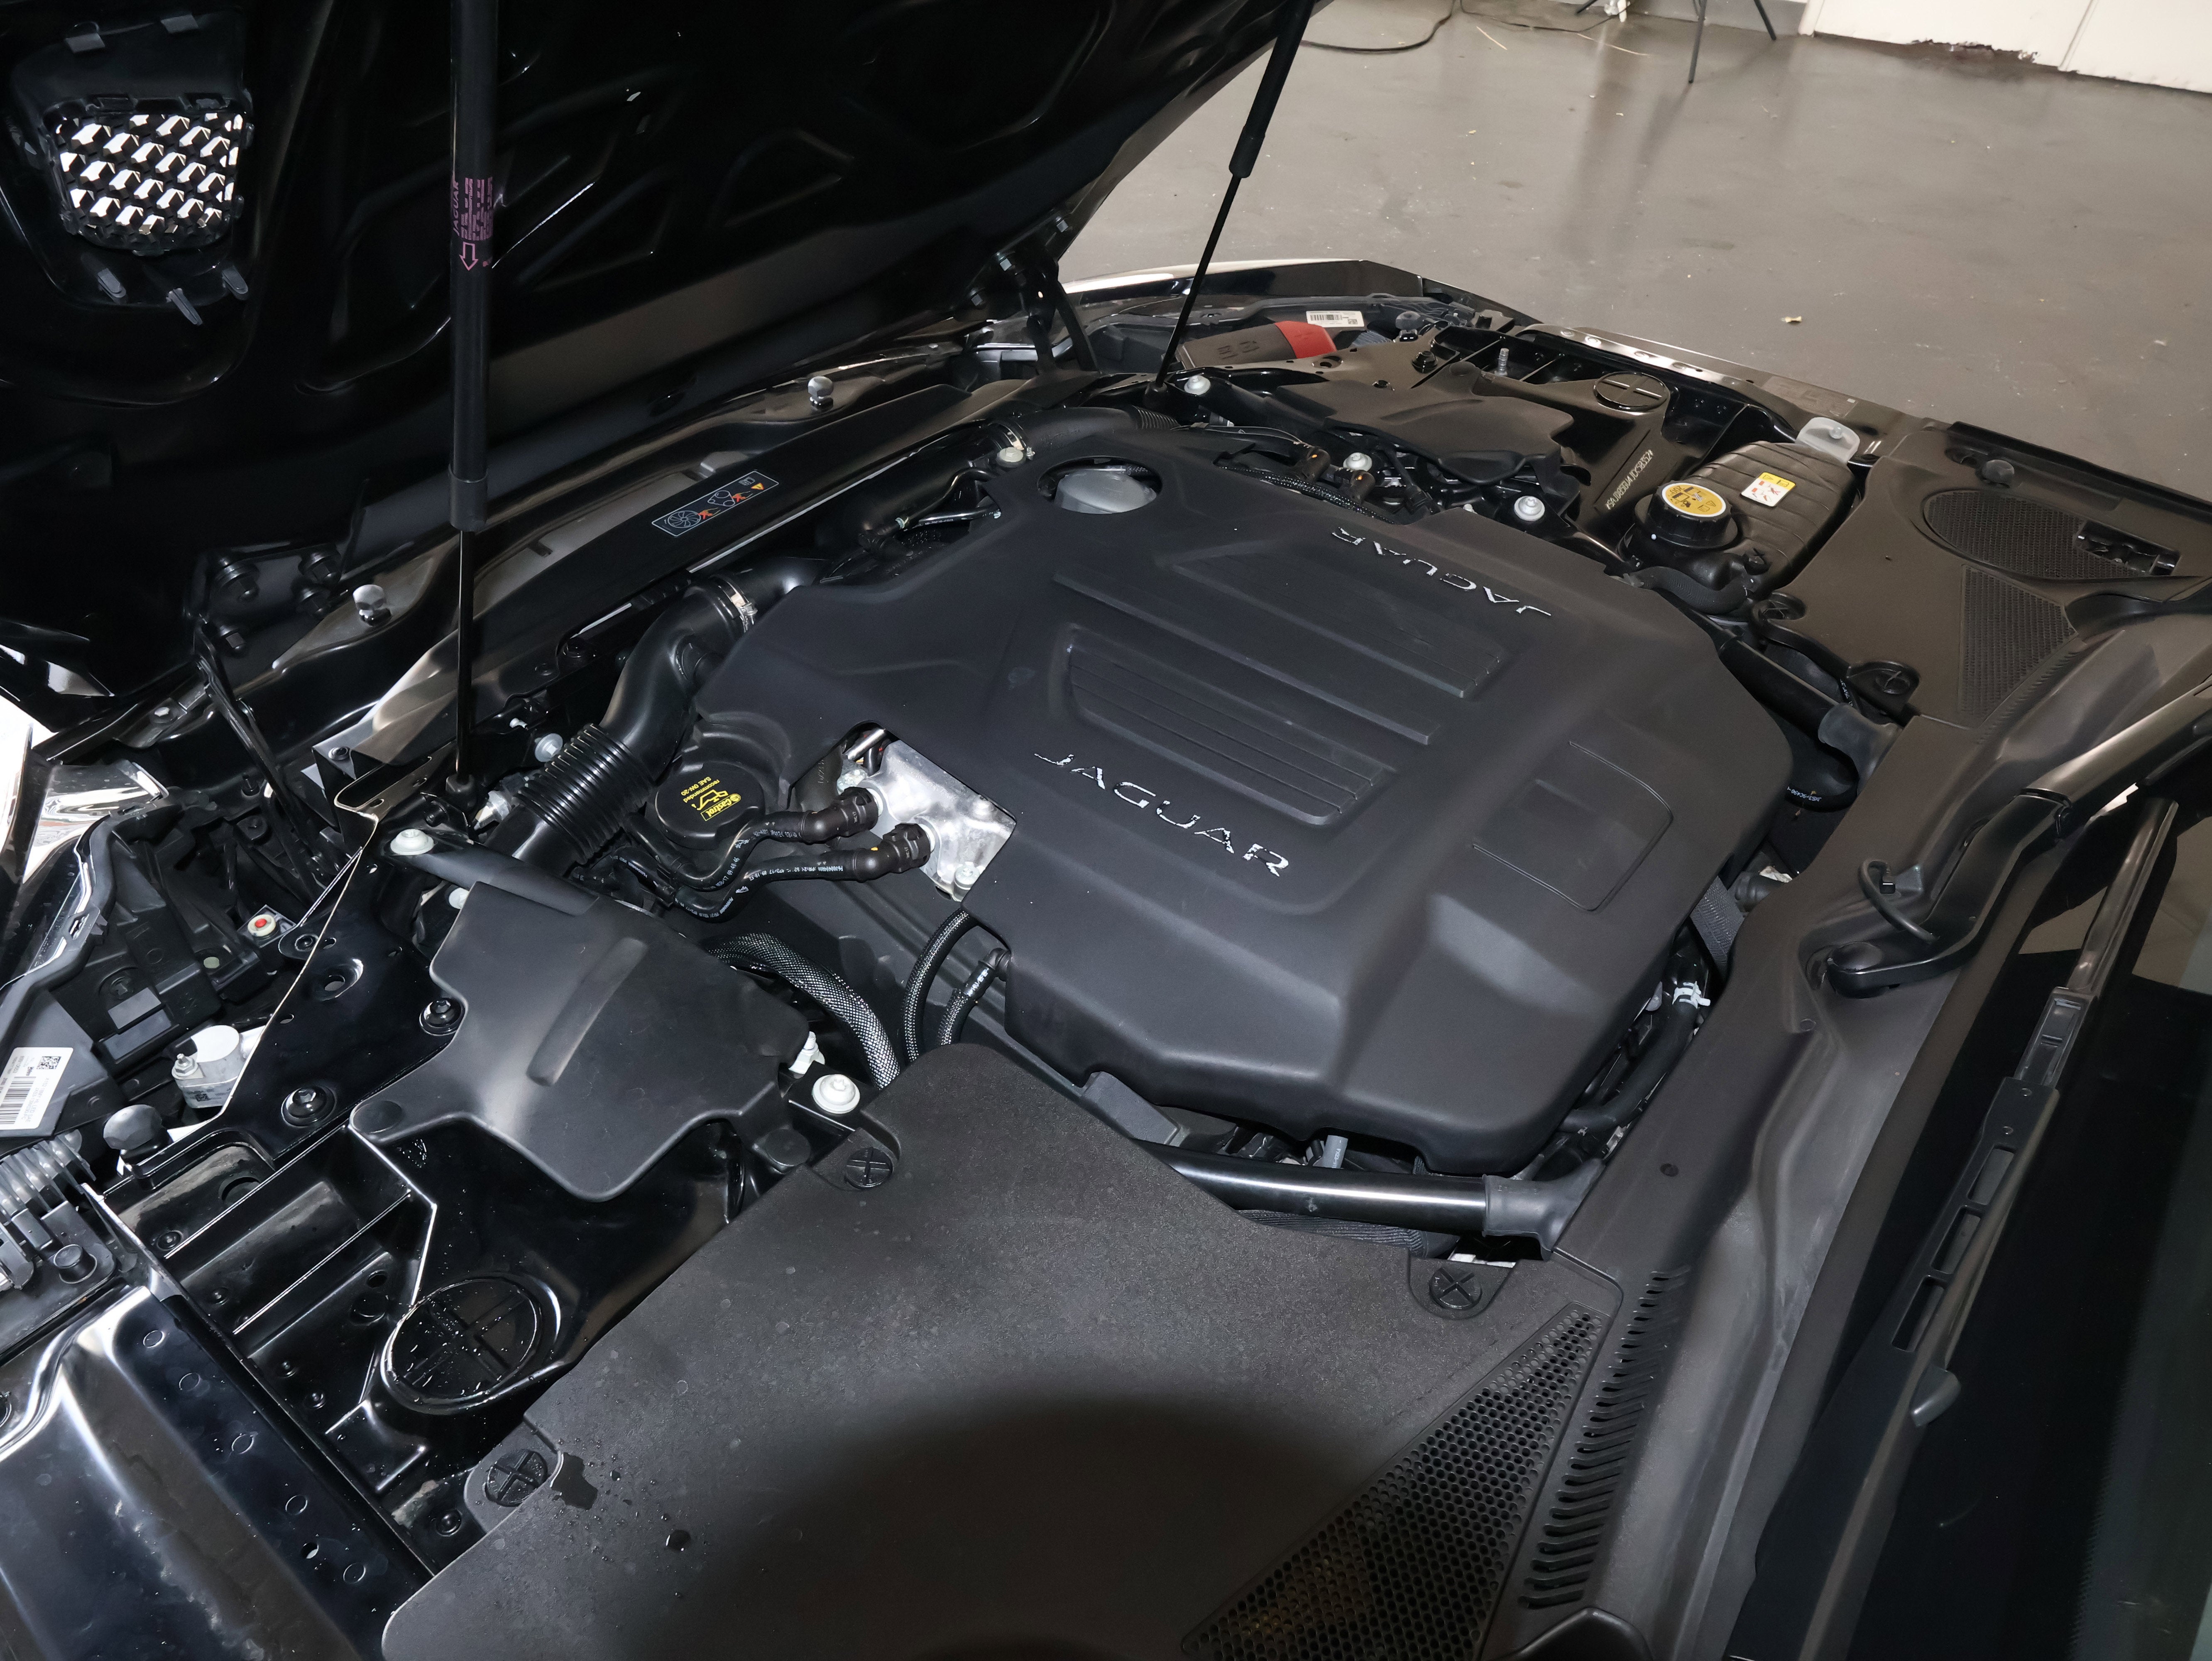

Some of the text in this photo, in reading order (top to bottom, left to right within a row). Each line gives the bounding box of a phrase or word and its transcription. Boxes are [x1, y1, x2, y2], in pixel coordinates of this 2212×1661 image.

[1331, 527, 1552, 618] JAGUAR
[681, 777, 712, 796] SAE 0W-20
[683, 779, 720, 804] recommended
[705, 797, 734, 818] Castrol
[1034, 752, 1291, 877] JAGUAR
